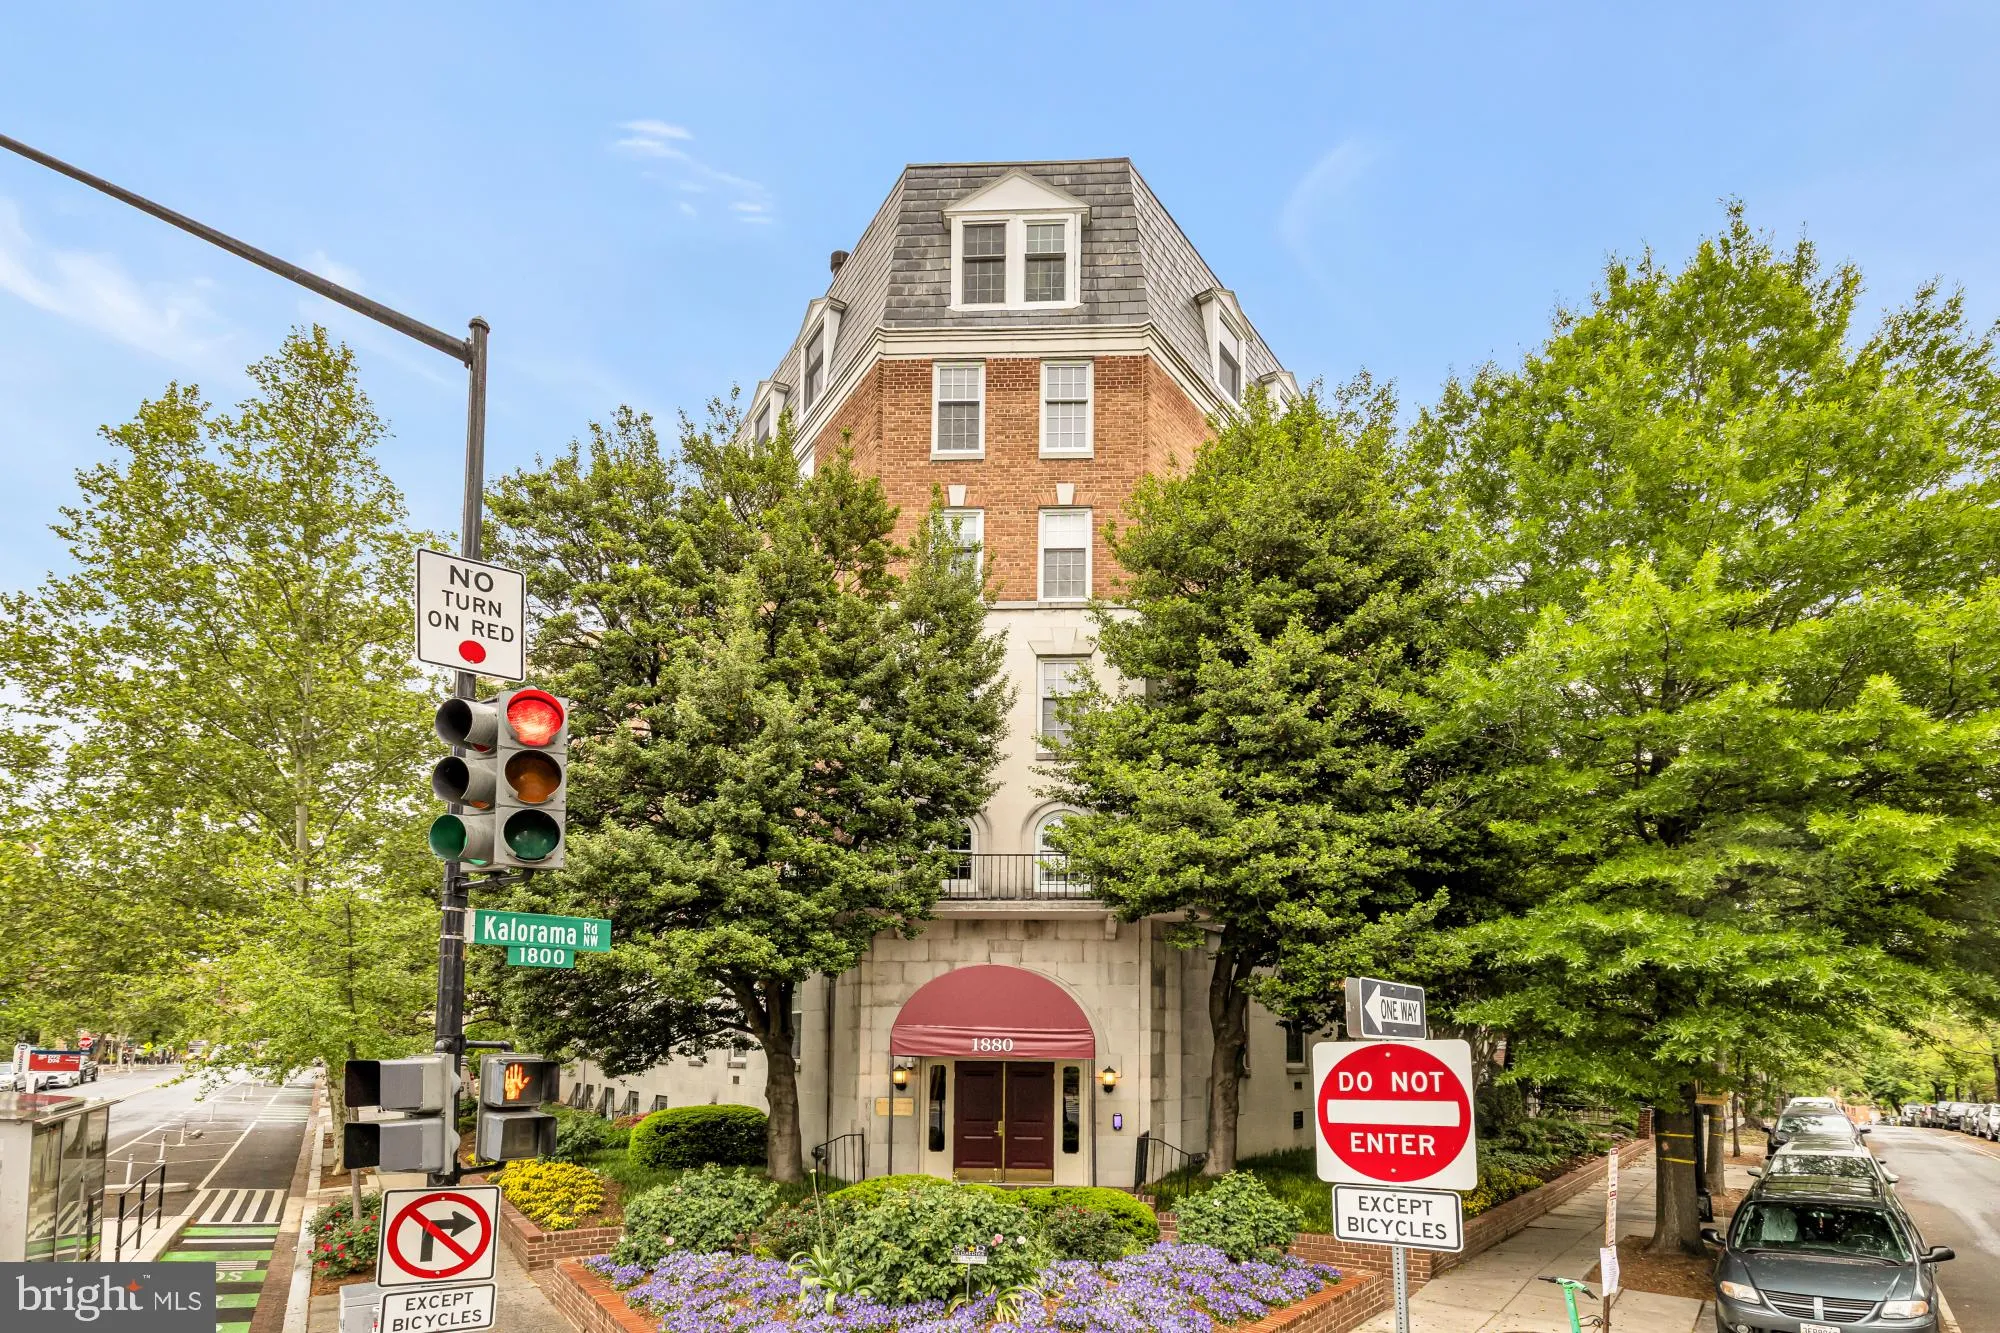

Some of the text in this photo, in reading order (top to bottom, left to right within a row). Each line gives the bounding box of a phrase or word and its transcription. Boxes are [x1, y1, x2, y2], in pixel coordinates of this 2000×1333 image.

[450, 564, 494, 592] NO
[441, 589, 502, 618] TURN
[428, 610, 514, 643] ON RED
[484, 915, 598, 945] Kalorama Rd
[583, 935, 599, 947] NW
[519, 947, 565, 965] 1800
[1381, 998, 1418, 1022] ONE WAY
[971, 1037, 1014, 1052] 1880
[1338, 1071, 1444, 1093] DO NOT
[1350, 1132, 1436, 1156] ENTER
[1358, 1195, 1433, 1216] EXCEPT
[1348, 1216, 1447, 1240] BICYCLES
[405, 1291, 474, 1311] EXCEPT
[392, 1309, 482, 1333] BICYCLES
